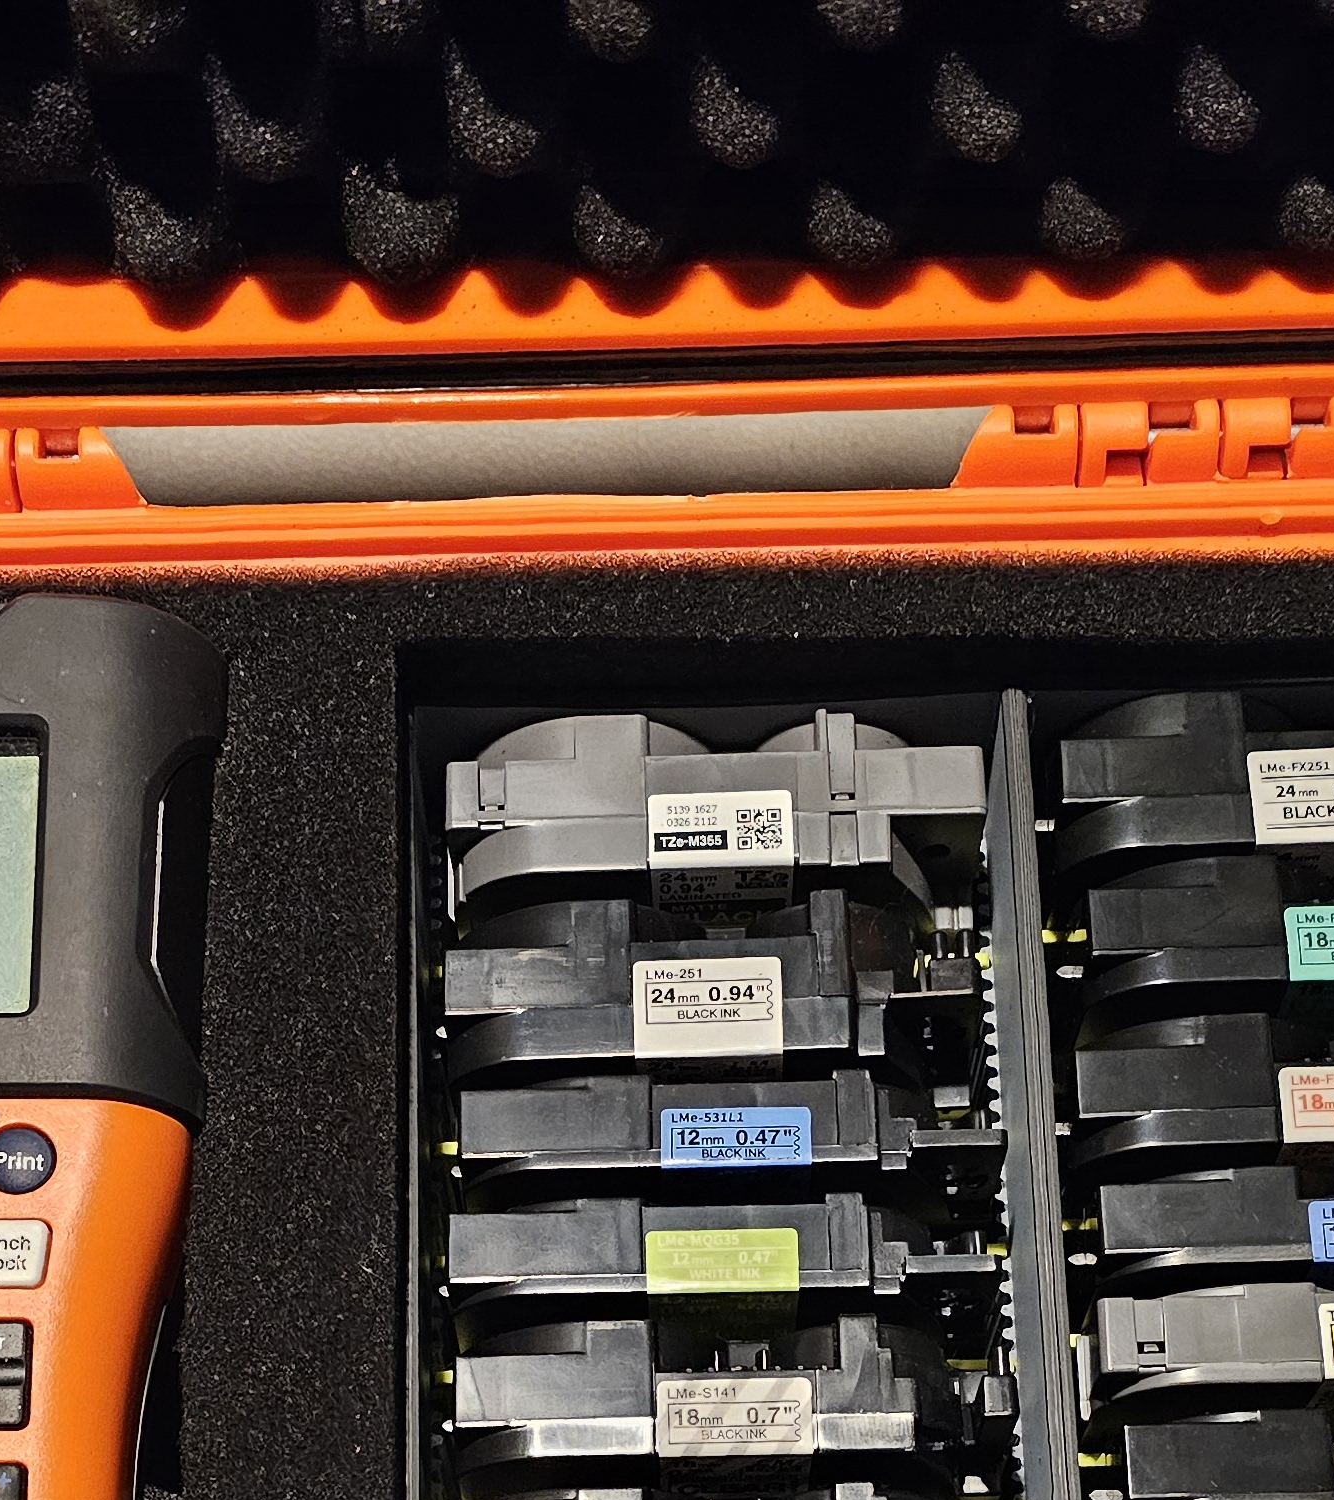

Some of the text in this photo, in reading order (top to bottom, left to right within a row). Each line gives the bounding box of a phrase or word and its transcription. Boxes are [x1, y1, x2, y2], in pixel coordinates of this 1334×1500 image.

[1260, 762, 1330, 773] LMe-FX251
[667, 805, 717, 815] 5139 1627
[667, 817, 717, 827] 0326 2112
[660, 835, 723, 848] TZe-M355
[645, 969, 702, 980] LMe-251
[678, 1009, 740, 1019] BLACK INK
[702, 1148, 765, 1158] BLACK INK
[668, 1388, 736, 1399] LMe-S141
[701, 1429, 767, 1440] BLACK INK
